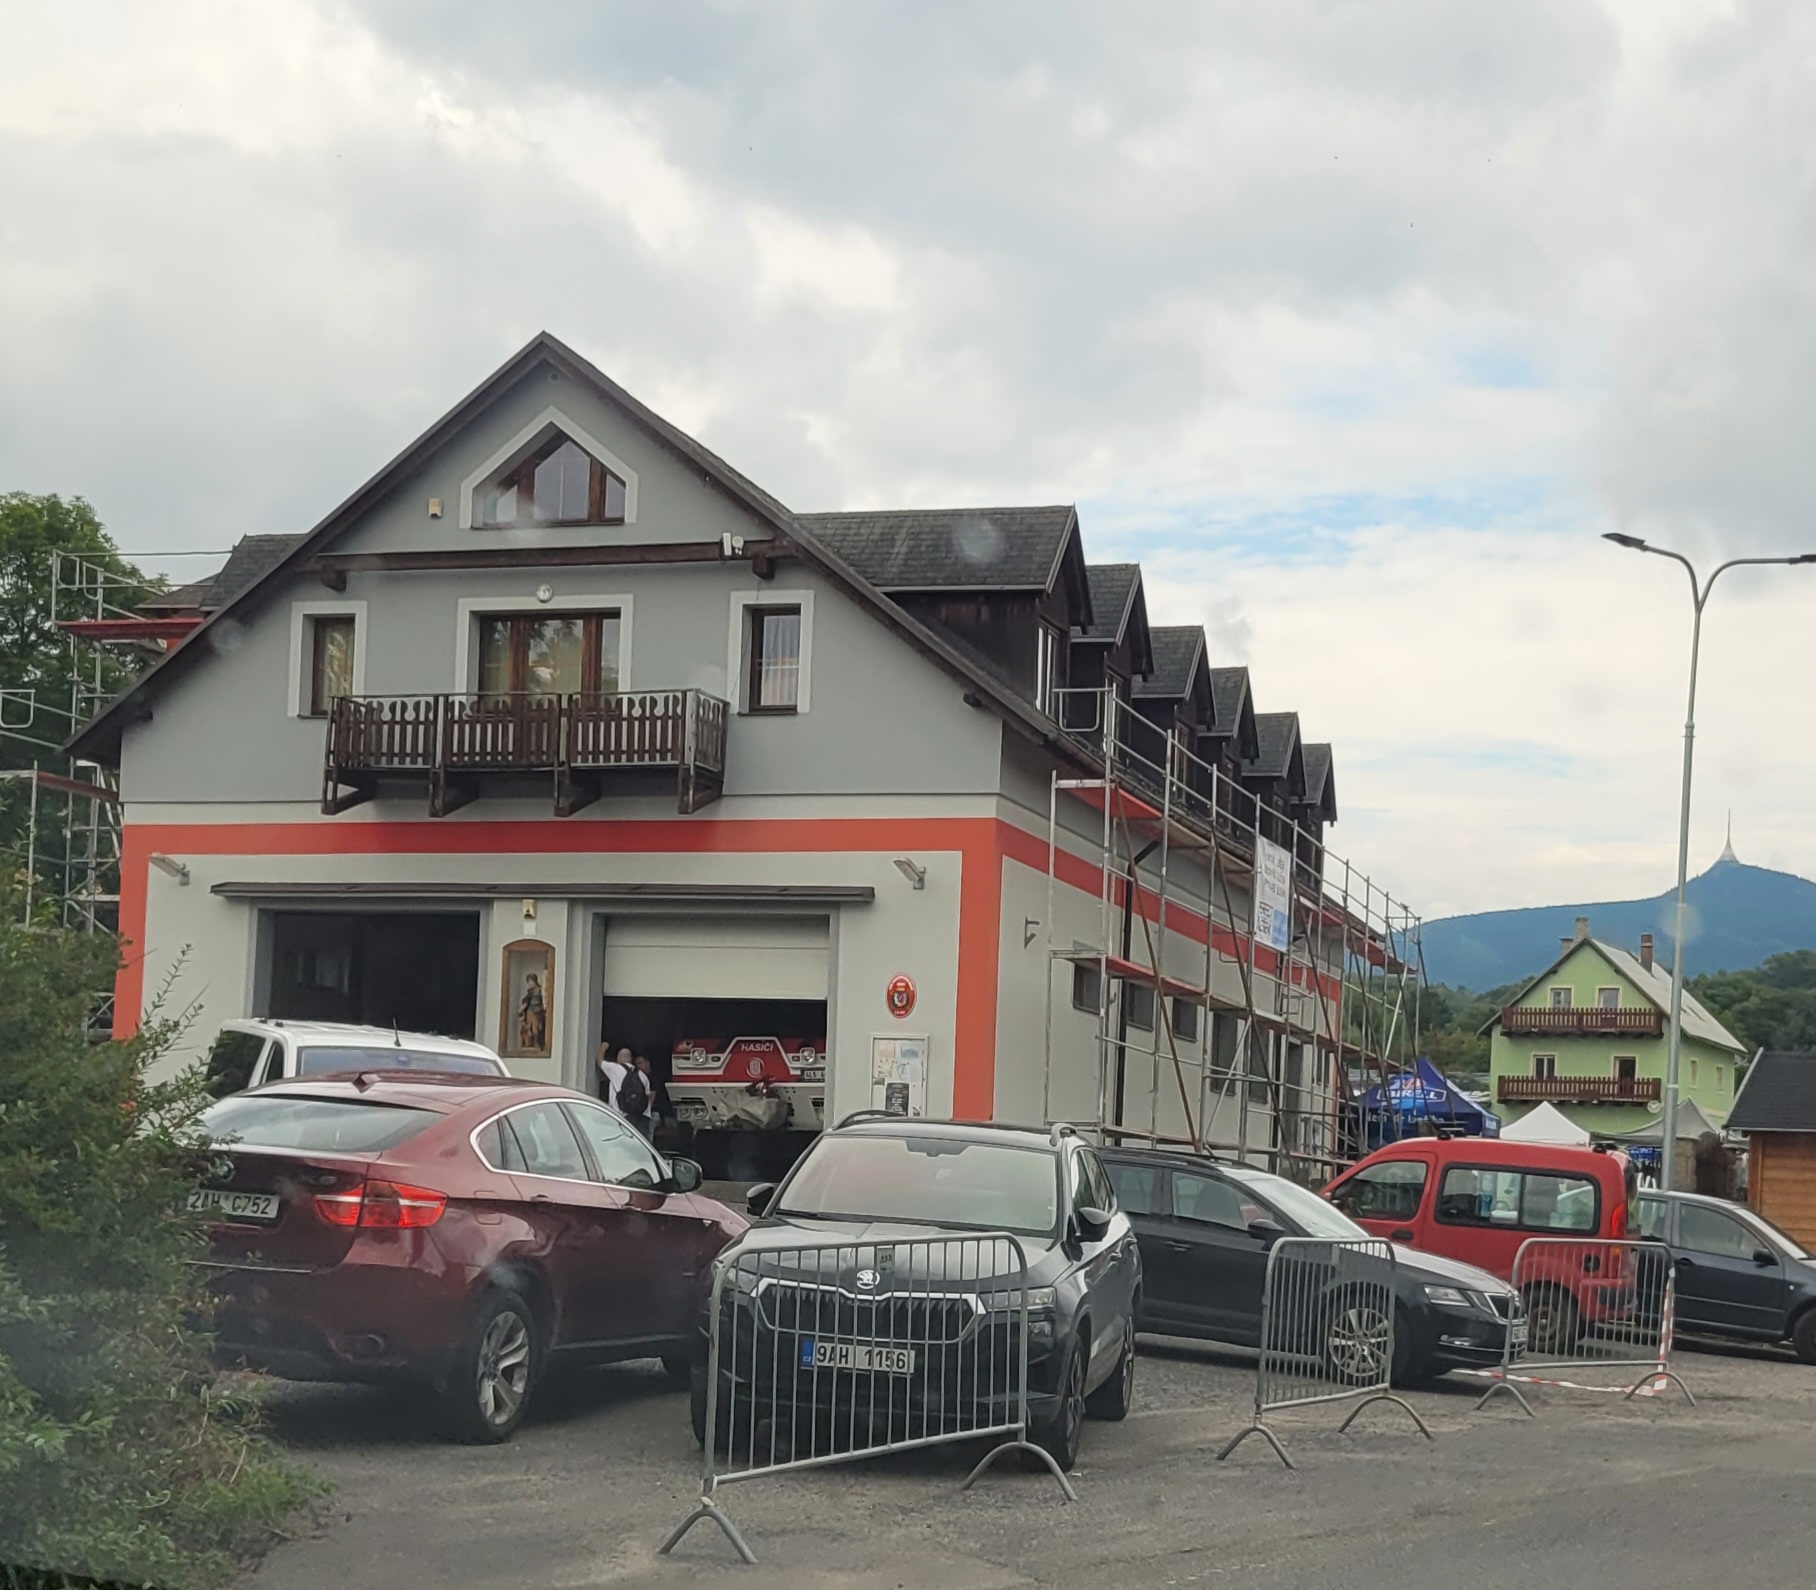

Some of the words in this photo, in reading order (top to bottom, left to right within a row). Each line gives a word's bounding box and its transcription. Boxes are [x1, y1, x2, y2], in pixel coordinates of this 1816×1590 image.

[741, 1041, 774, 1052] HASIČI
[817, 1345, 849, 1365] 9AH
[864, 1349, 907, 1370] 1156
